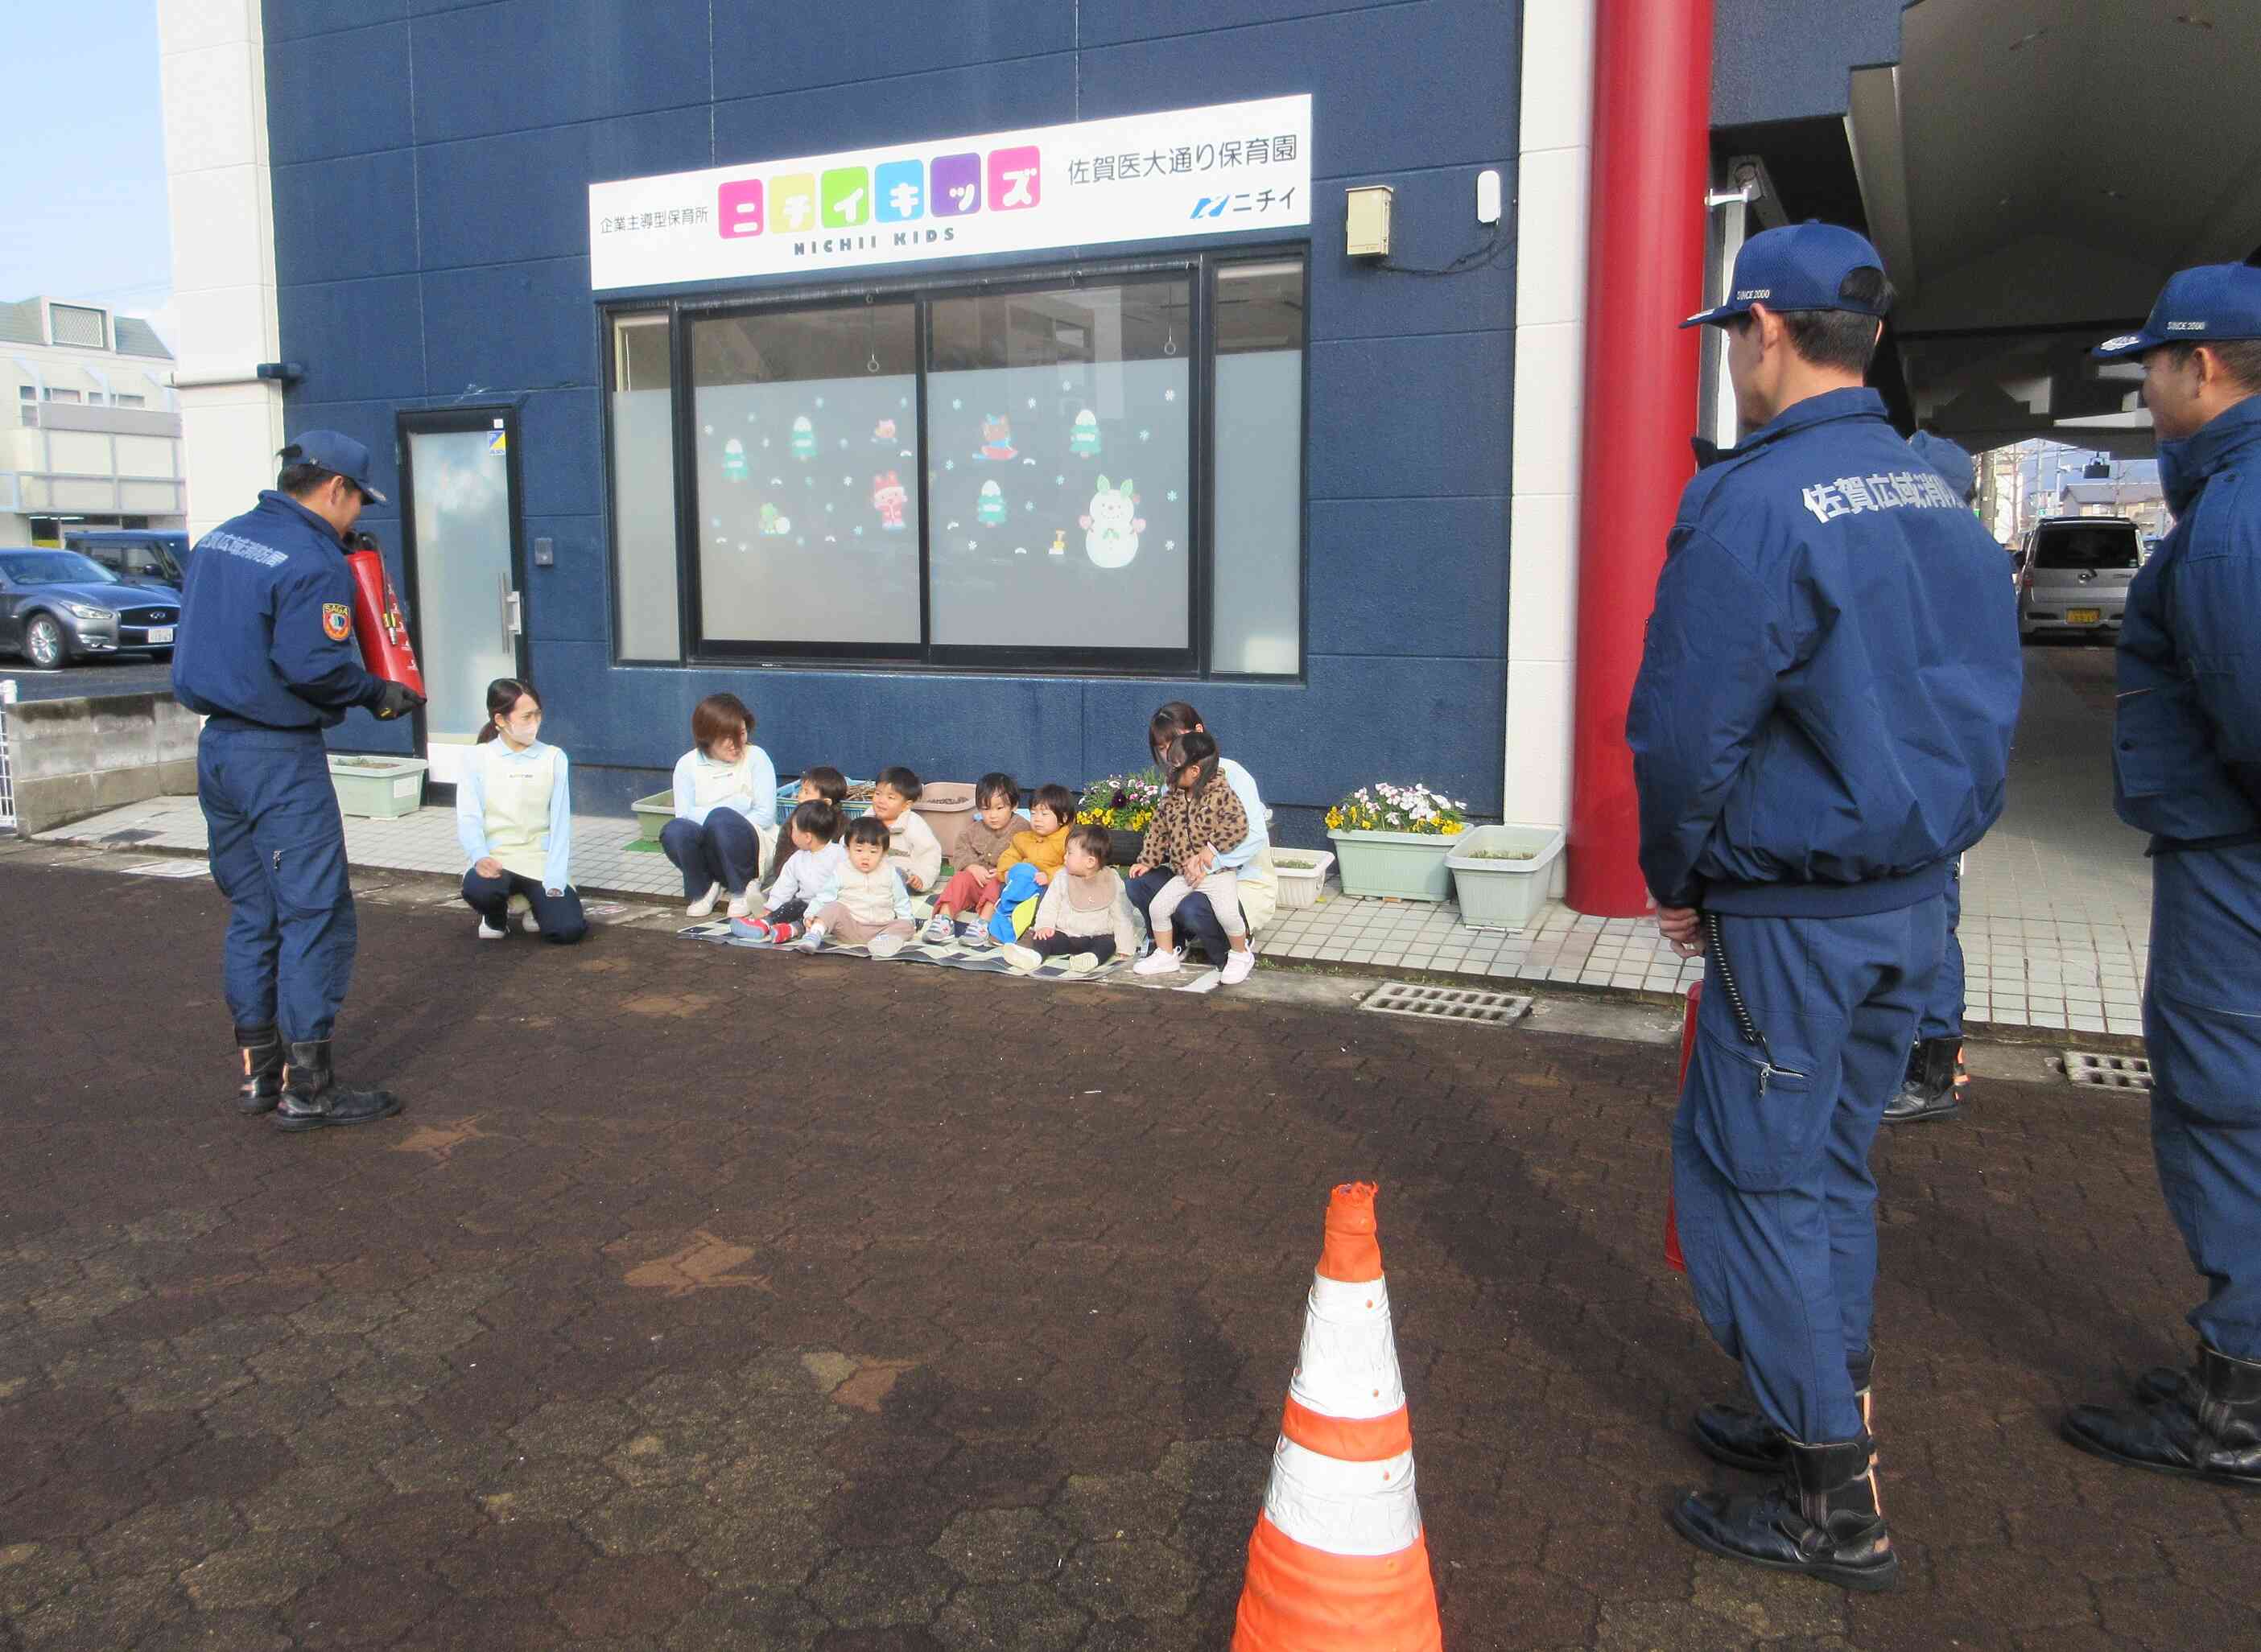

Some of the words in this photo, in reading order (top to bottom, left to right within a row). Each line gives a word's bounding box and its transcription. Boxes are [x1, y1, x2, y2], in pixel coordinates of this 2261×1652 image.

[1067, 134, 1298, 186] 佐賀医大通り保育園
[732, 167, 1038, 234] ニチイキッズ
[1232, 187, 1295, 212] ニチイ
[600, 206, 709, 234] 企業主導型保育所
[794, 235, 877, 256] NICHII
[893, 227, 955, 246] KIDS
[325, 604, 349, 615] SAGA
